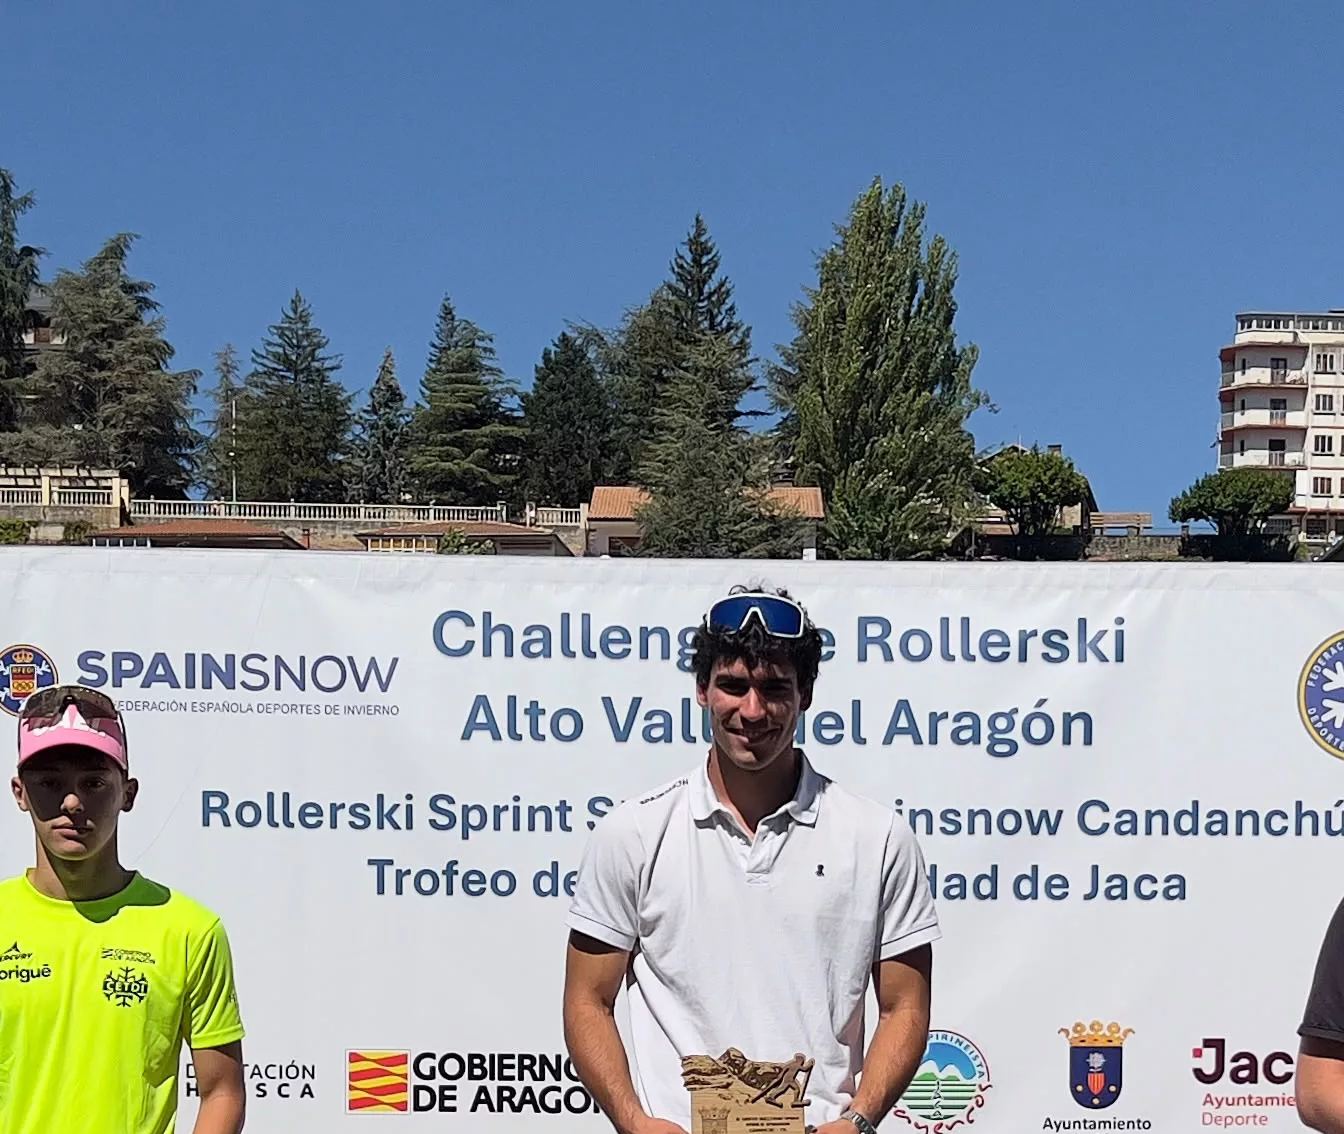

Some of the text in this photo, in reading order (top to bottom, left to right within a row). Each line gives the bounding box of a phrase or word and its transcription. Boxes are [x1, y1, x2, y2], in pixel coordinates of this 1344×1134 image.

[432, 609, 696, 672] Challeng
[856, 615, 1126, 663] Rollerski
[76, 650, 400, 693] SPAINSNOW
[191, 700, 254, 714] ESPAÑOLA
[256, 703, 321, 716] DEPORTES
[324, 704, 340, 716] DE
[343, 704, 400, 717] INVIERNO
[460, 694, 584, 743] Alto
[600, 696, 707, 744] Vall
[882, 697, 1094, 758] Aragón
[200, 789, 413, 830] Rollerski
[427, 793, 573, 839] Sprint
[367, 858, 516, 896] Trofeo
[1013, 863, 1069, 900] de
[1084, 865, 1187, 901] Jaca
[1192, 1038, 1294, 1085] Jac
[413, 1086, 457, 1113] DE
[1202, 1092, 1296, 1110] Ayuntamie
[1042, 1116, 1152, 1134] Ayuntamiento
[1201, 1111, 1269, 1129] Deporte
